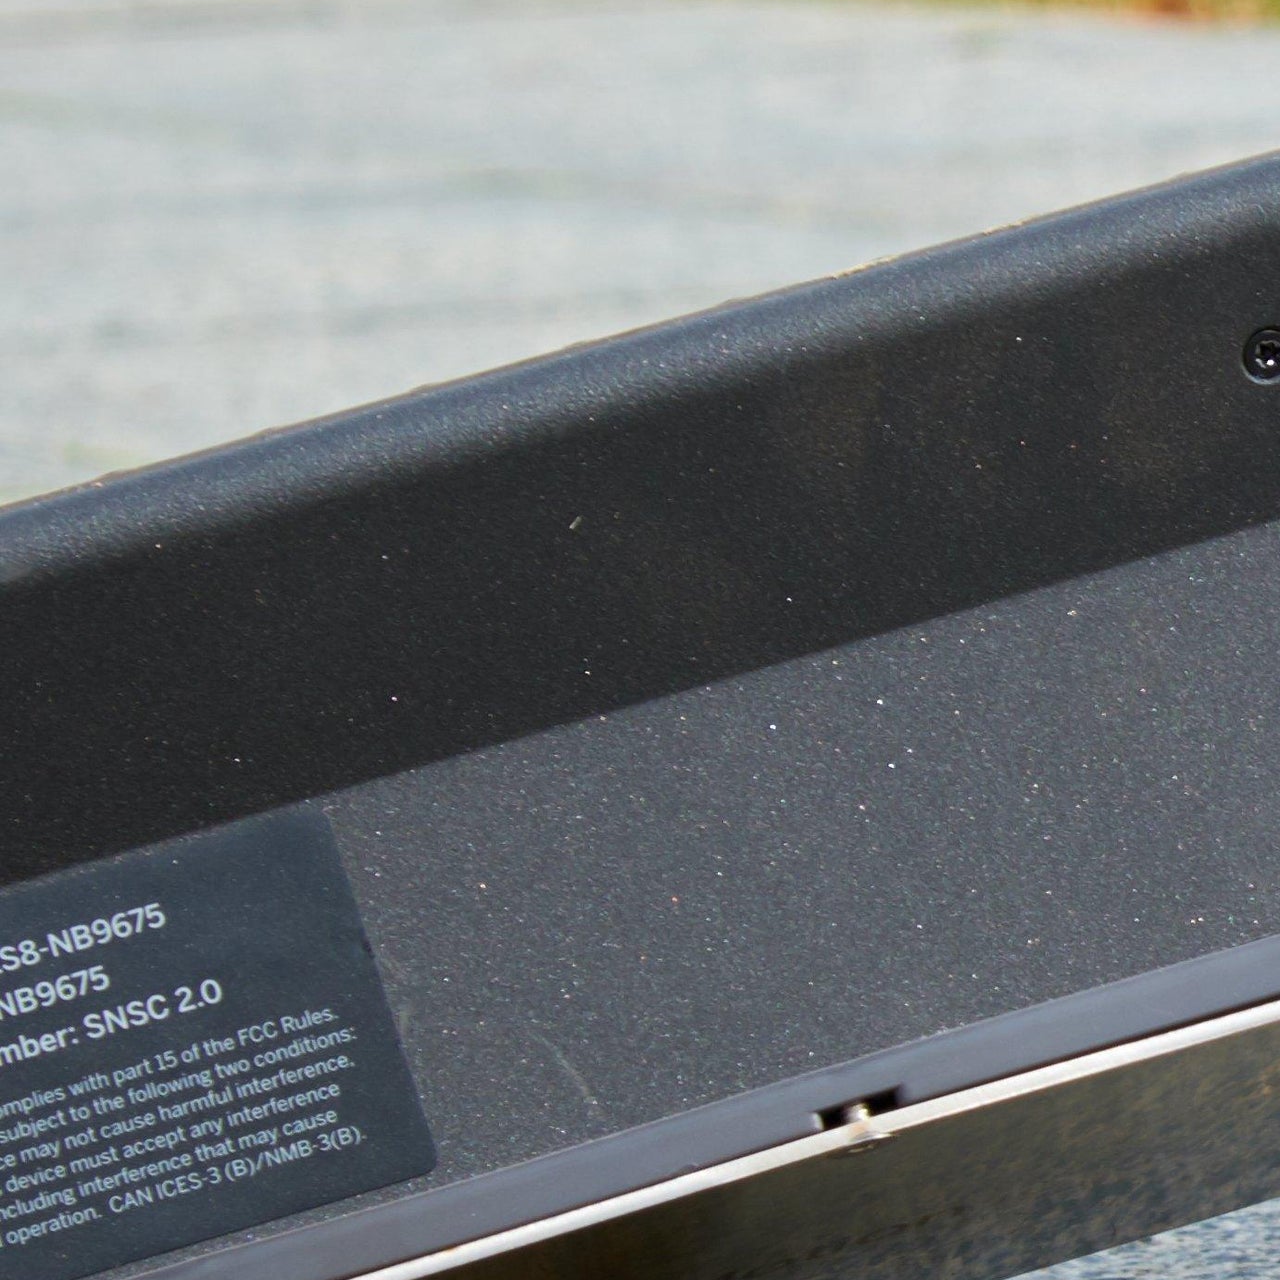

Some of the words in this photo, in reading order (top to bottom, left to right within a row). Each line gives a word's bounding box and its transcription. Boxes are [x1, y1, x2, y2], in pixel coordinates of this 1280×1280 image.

[0, 902, 167, 973] S8-NB9675
[68, 1073, 110, 1096] with
[113, 1058, 154, 1087] part
[154, 1050, 178, 1071] 15
[181, 1043, 201, 1063] of
[203, 1037, 235, 1057] the
[237, 1021, 278, 1046] FCC
[280, 1008, 339, 1034] Rules.
[83, 993, 170, 1039] SNSC
[174, 979, 222, 1013] 2.0
[0, 1110, 66, 1144] subject
[69, 1106, 91, 1122] to
[93, 1096, 126, 1115] the
[128, 1070, 214, 1104] following
[214, 1059, 250, 1079] two
[253, 1027, 358, 1068] conditions:
[20, 1140, 60, 1164] may
[64, 1126, 98, 1150] not
[100, 1112, 155, 1139] cause
[157, 1086, 234, 1121] harmful
[235, 1054, 356, 1099] interference.
[6, 1164, 67, 1193] device
[70, 1146, 120, 1174] must
[123, 1126, 188, 1158] accept
[190, 1118, 223, 1137] any
[227, 1083, 341, 1127] interference
[78, 1152, 193, 1198] interference
[195, 1137, 236, 1162] that
[238, 1127, 279, 1150] may
[282, 1109, 338, 1136] cause
[6, 1206, 103, 1245] operation.
[108, 1186, 154, 1213] CAN
[155, 1166, 222, 1201] ICES-3
